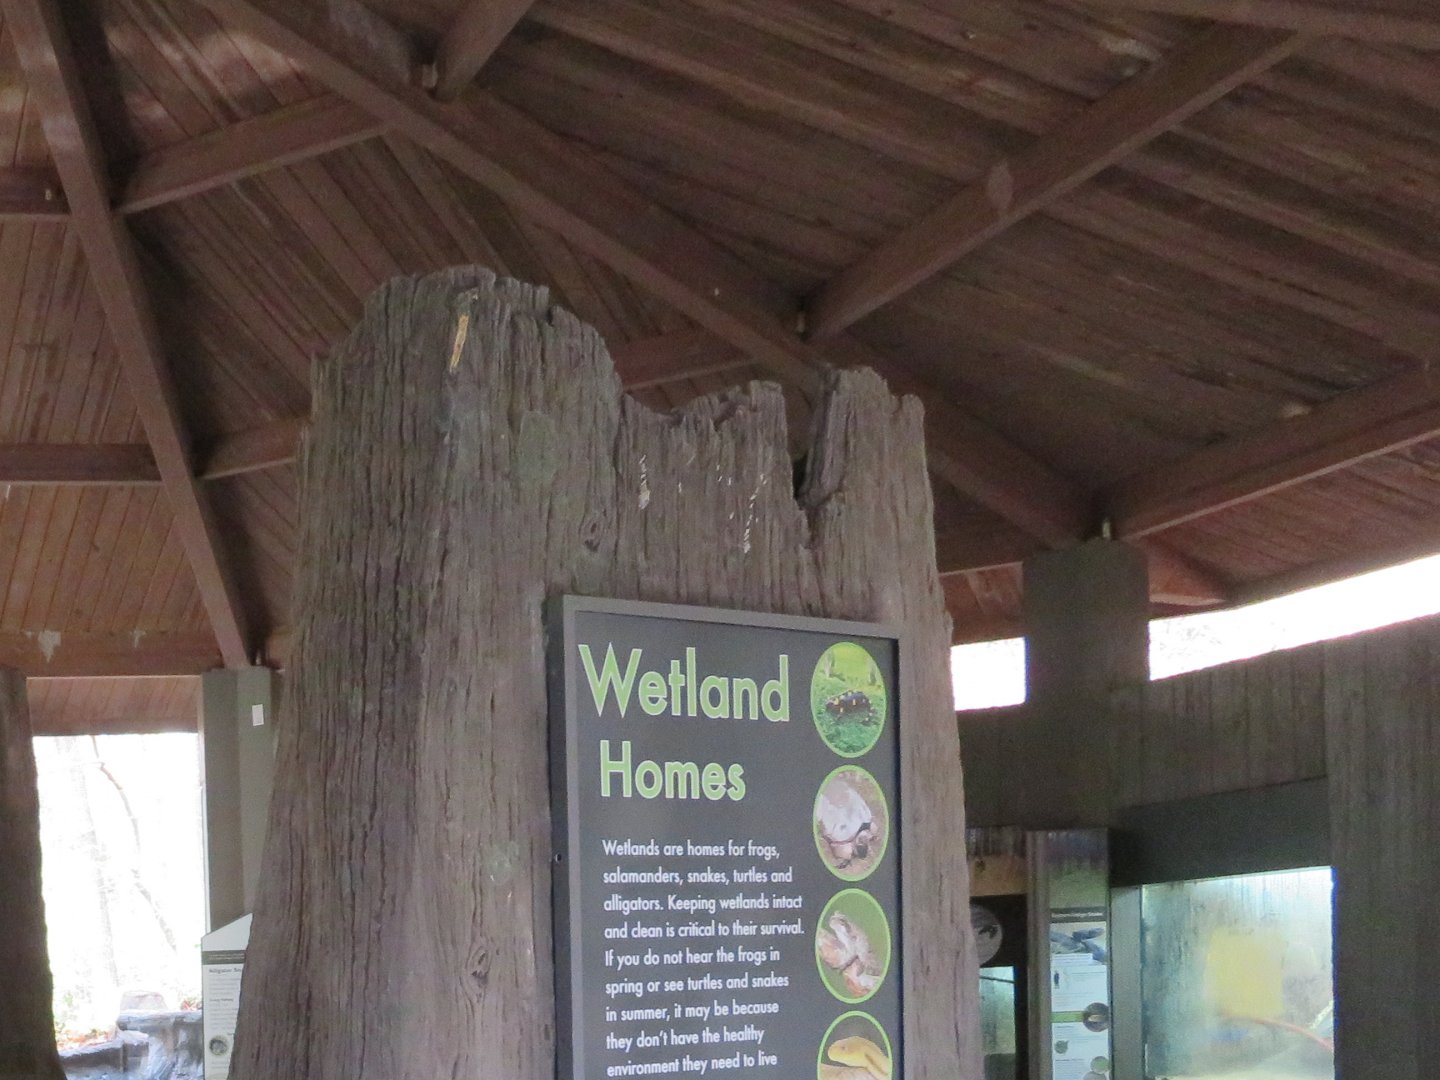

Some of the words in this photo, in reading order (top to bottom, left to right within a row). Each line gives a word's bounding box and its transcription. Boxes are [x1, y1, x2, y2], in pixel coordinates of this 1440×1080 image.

[578, 642, 790, 722] Wetland
[600, 740, 746, 800] Homes
[602, 839, 660, 856] Wetlands
[663, 843, 683, 855] are
[687, 840, 725, 856] homes
[728, 840, 745, 855] for
[748, 840, 780, 860] frogs,
[603, 866, 683, 885] salamanders,
[687, 867, 729, 885] snakes,
[733, 866, 767, 882] turtles
[771, 867, 793, 882] and
[604, 894, 664, 915] alligators.
[668, 894, 715, 914] Keeping
[720, 893, 769, 909] wetlands
[772, 894, 802, 908] intact
[604, 922, 628, 938] and
[631, 921, 662, 937] clean
[666, 922, 674, 937] is
[678, 920, 715, 936] critical
[718, 922, 729, 936] to
[732, 919, 757, 935] their
[760, 918, 805, 935] survival.
[605, 949, 614, 966] If
[617, 953, 639, 970] you
[644, 948, 659, 965] do
[664, 951, 683, 964] not
[686, 948, 713, 964] hear
[717, 946, 734, 963] the
[738, 945, 766, 966] frogs
[770, 946, 780, 961] in
[605, 978, 643, 998] spring
[647, 980, 660, 992] or
[664, 979, 684, 991] see
[688, 973, 723, 990] turtles
[727, 972, 748, 989] and
[752, 971, 789, 988] snakes
[606, 1006, 617, 1022] in
[621, 1006, 670, 1021] summer,
[674, 1003, 682, 1018] it
[685, 1006, 710, 1021] may
[714, 1000, 729, 1016] be
[733, 999, 779, 1014] because
[606, 1032, 632, 1053] they
[671, 1029, 699, 1045] have
[702, 1027, 720, 1043] the
[724, 1024, 765, 1044] healthy
[607, 1059, 679, 1077] environment
[682, 1055, 708, 1075] they
[711, 1052, 740, 1069] need
[743, 1053, 755, 1067] to
[758, 1050, 777, 1066] live
